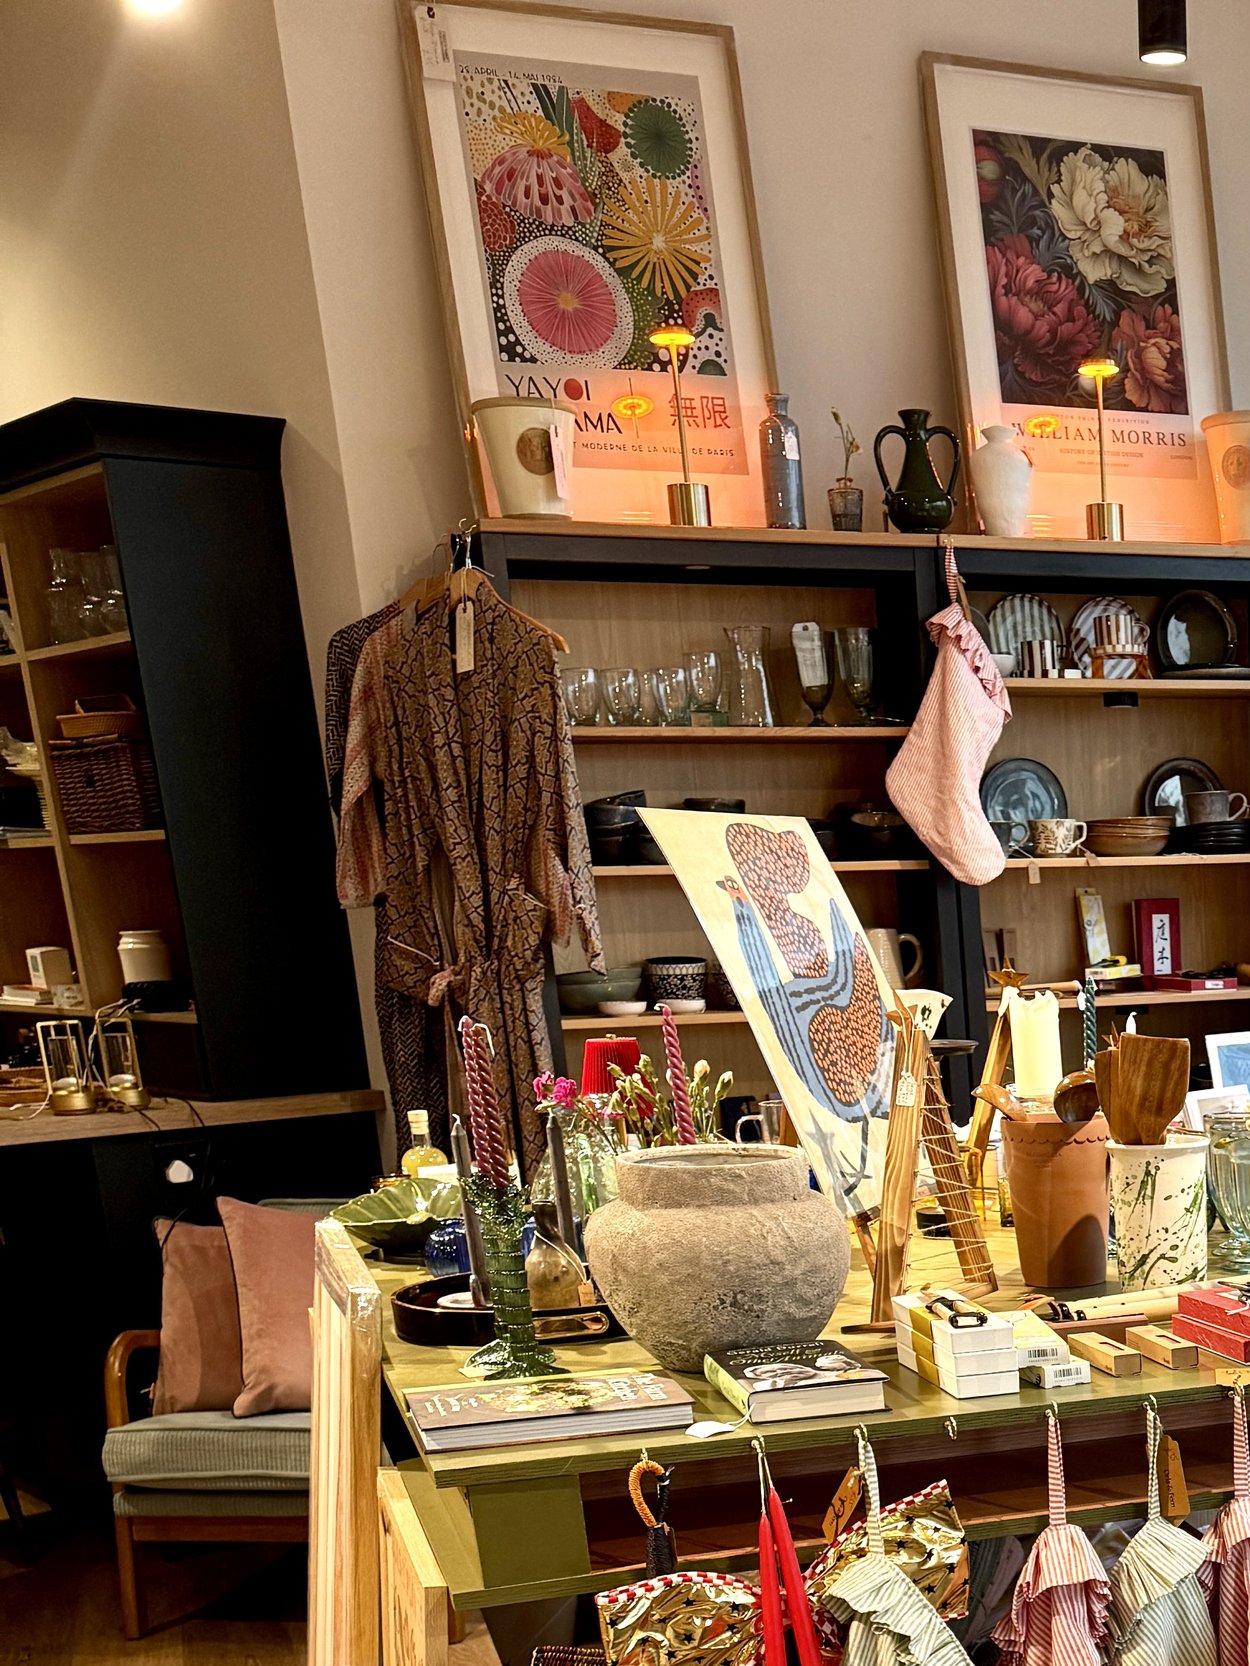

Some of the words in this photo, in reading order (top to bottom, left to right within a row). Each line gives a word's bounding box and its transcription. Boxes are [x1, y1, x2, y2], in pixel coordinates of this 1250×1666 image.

[474, 66, 500, 77] APRIL
[523, 72, 539, 81] MAI
[505, 374, 591, 401] YAYOI
[1111, 429, 1187, 447] MORRIS
[582, 441, 628, 451] MODERNE
[707, 448, 734, 457] PARIS
[727, 1346, 772, 1356] Gerald
[776, 1341, 825, 1351] Durrell
